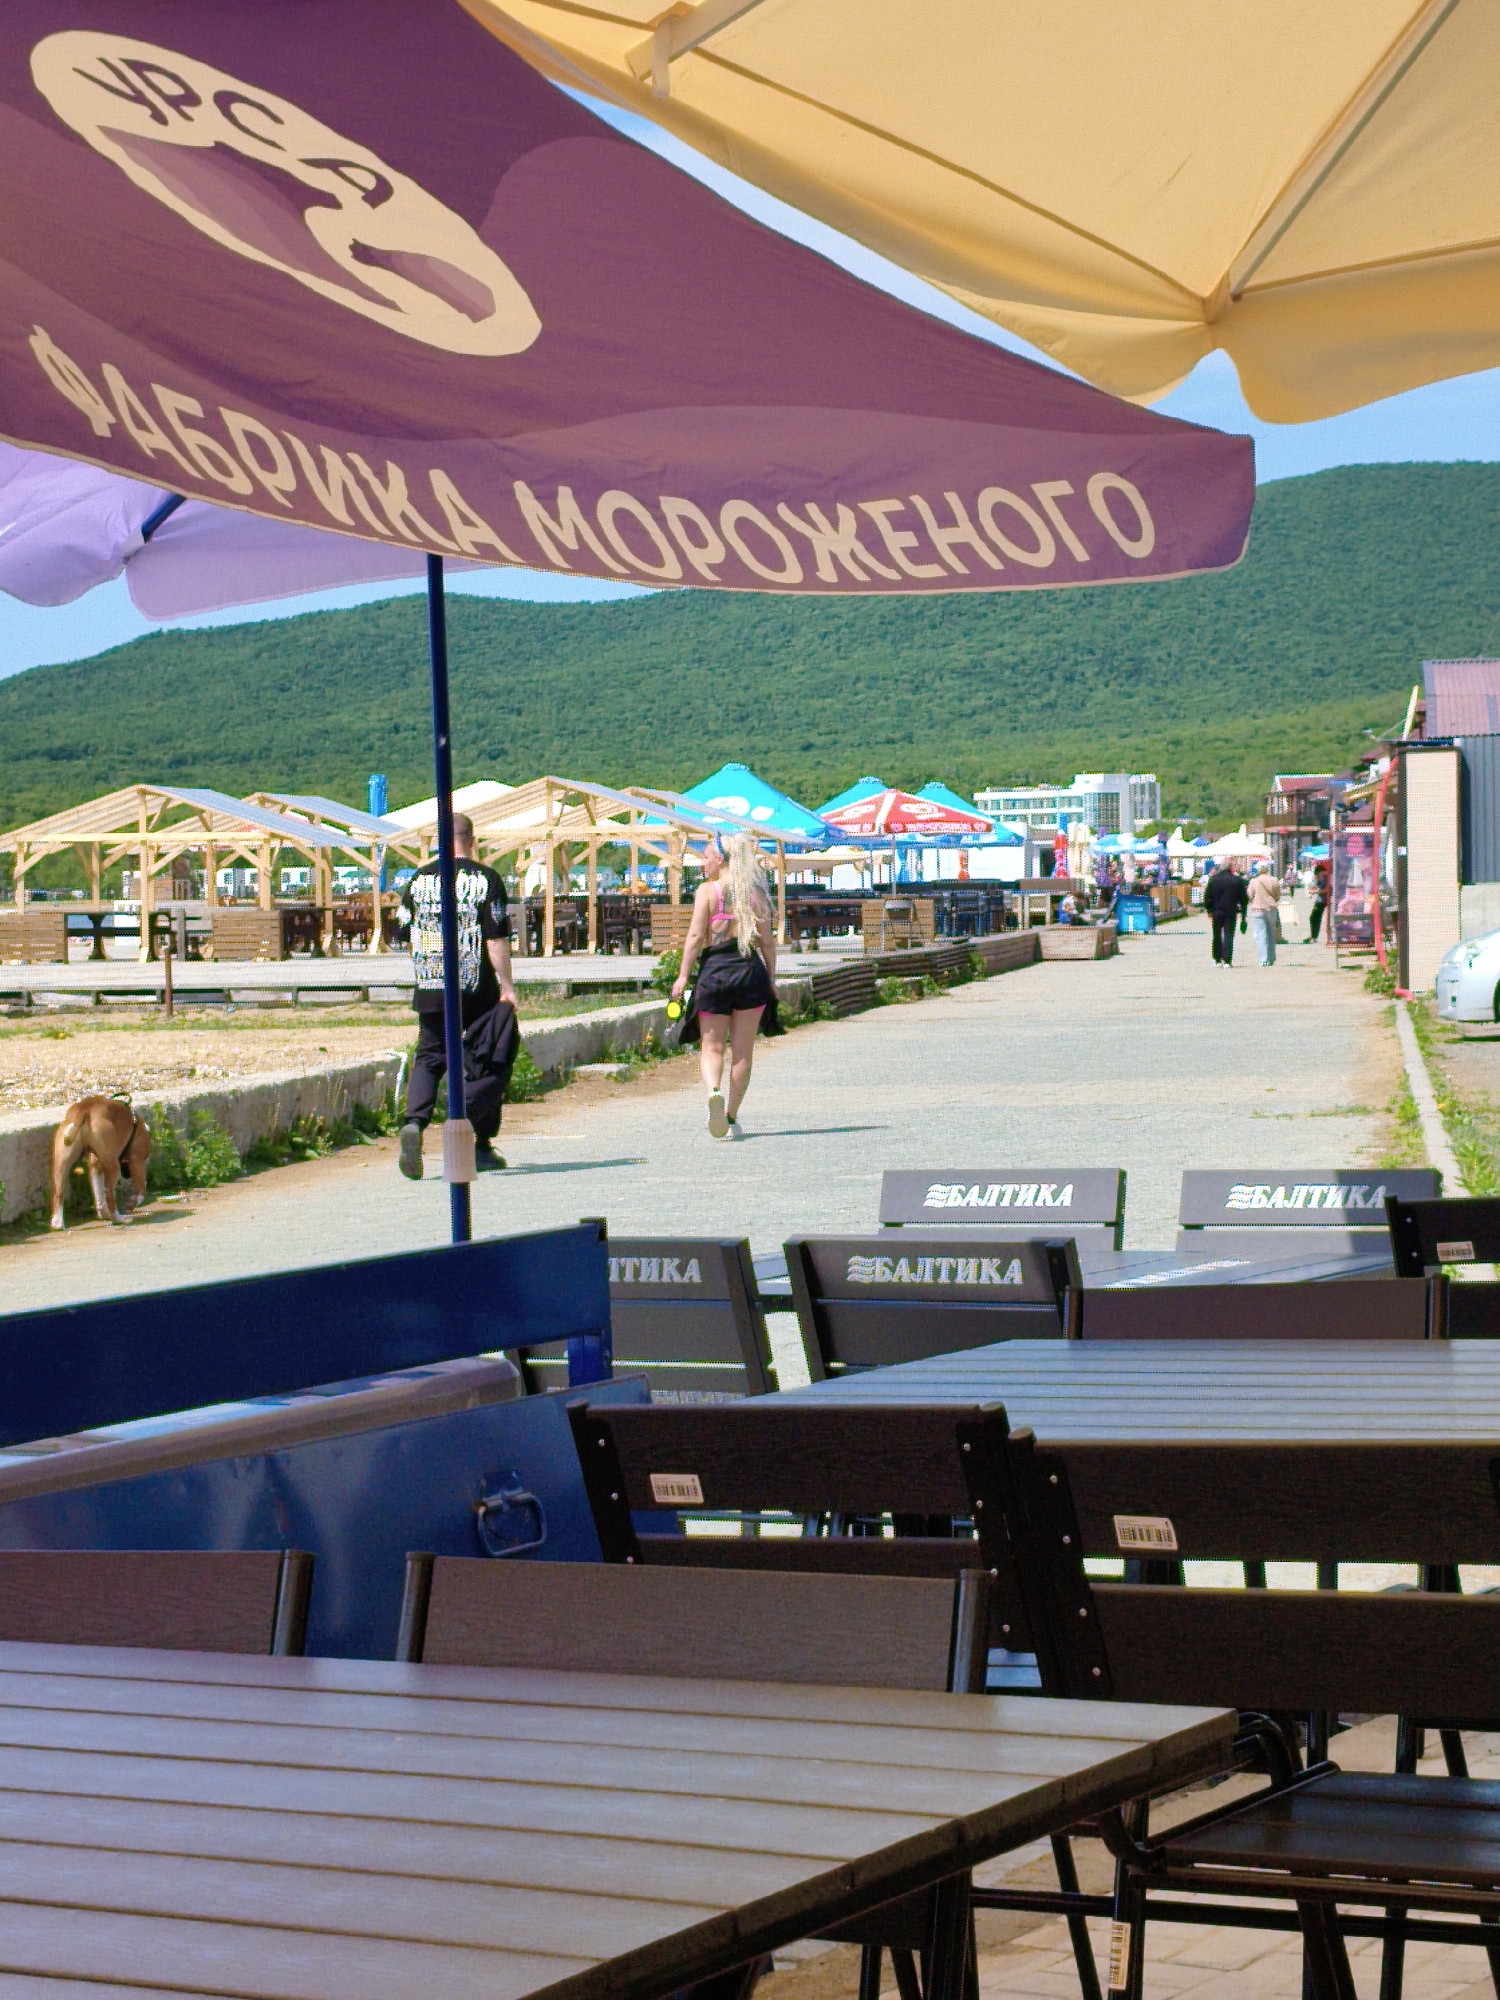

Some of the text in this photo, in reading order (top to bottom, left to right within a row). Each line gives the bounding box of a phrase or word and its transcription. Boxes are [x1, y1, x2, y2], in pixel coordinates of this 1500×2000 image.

[29, 324, 1156, 584] ФАБРИКА МОРОЖЕНОГО
[947, 1183, 1074, 1208] БАЛТИКА
[1249, 1184, 1387, 1209] БАЛТИКА
[870, 1256, 1023, 1285] БАЛТИКА
